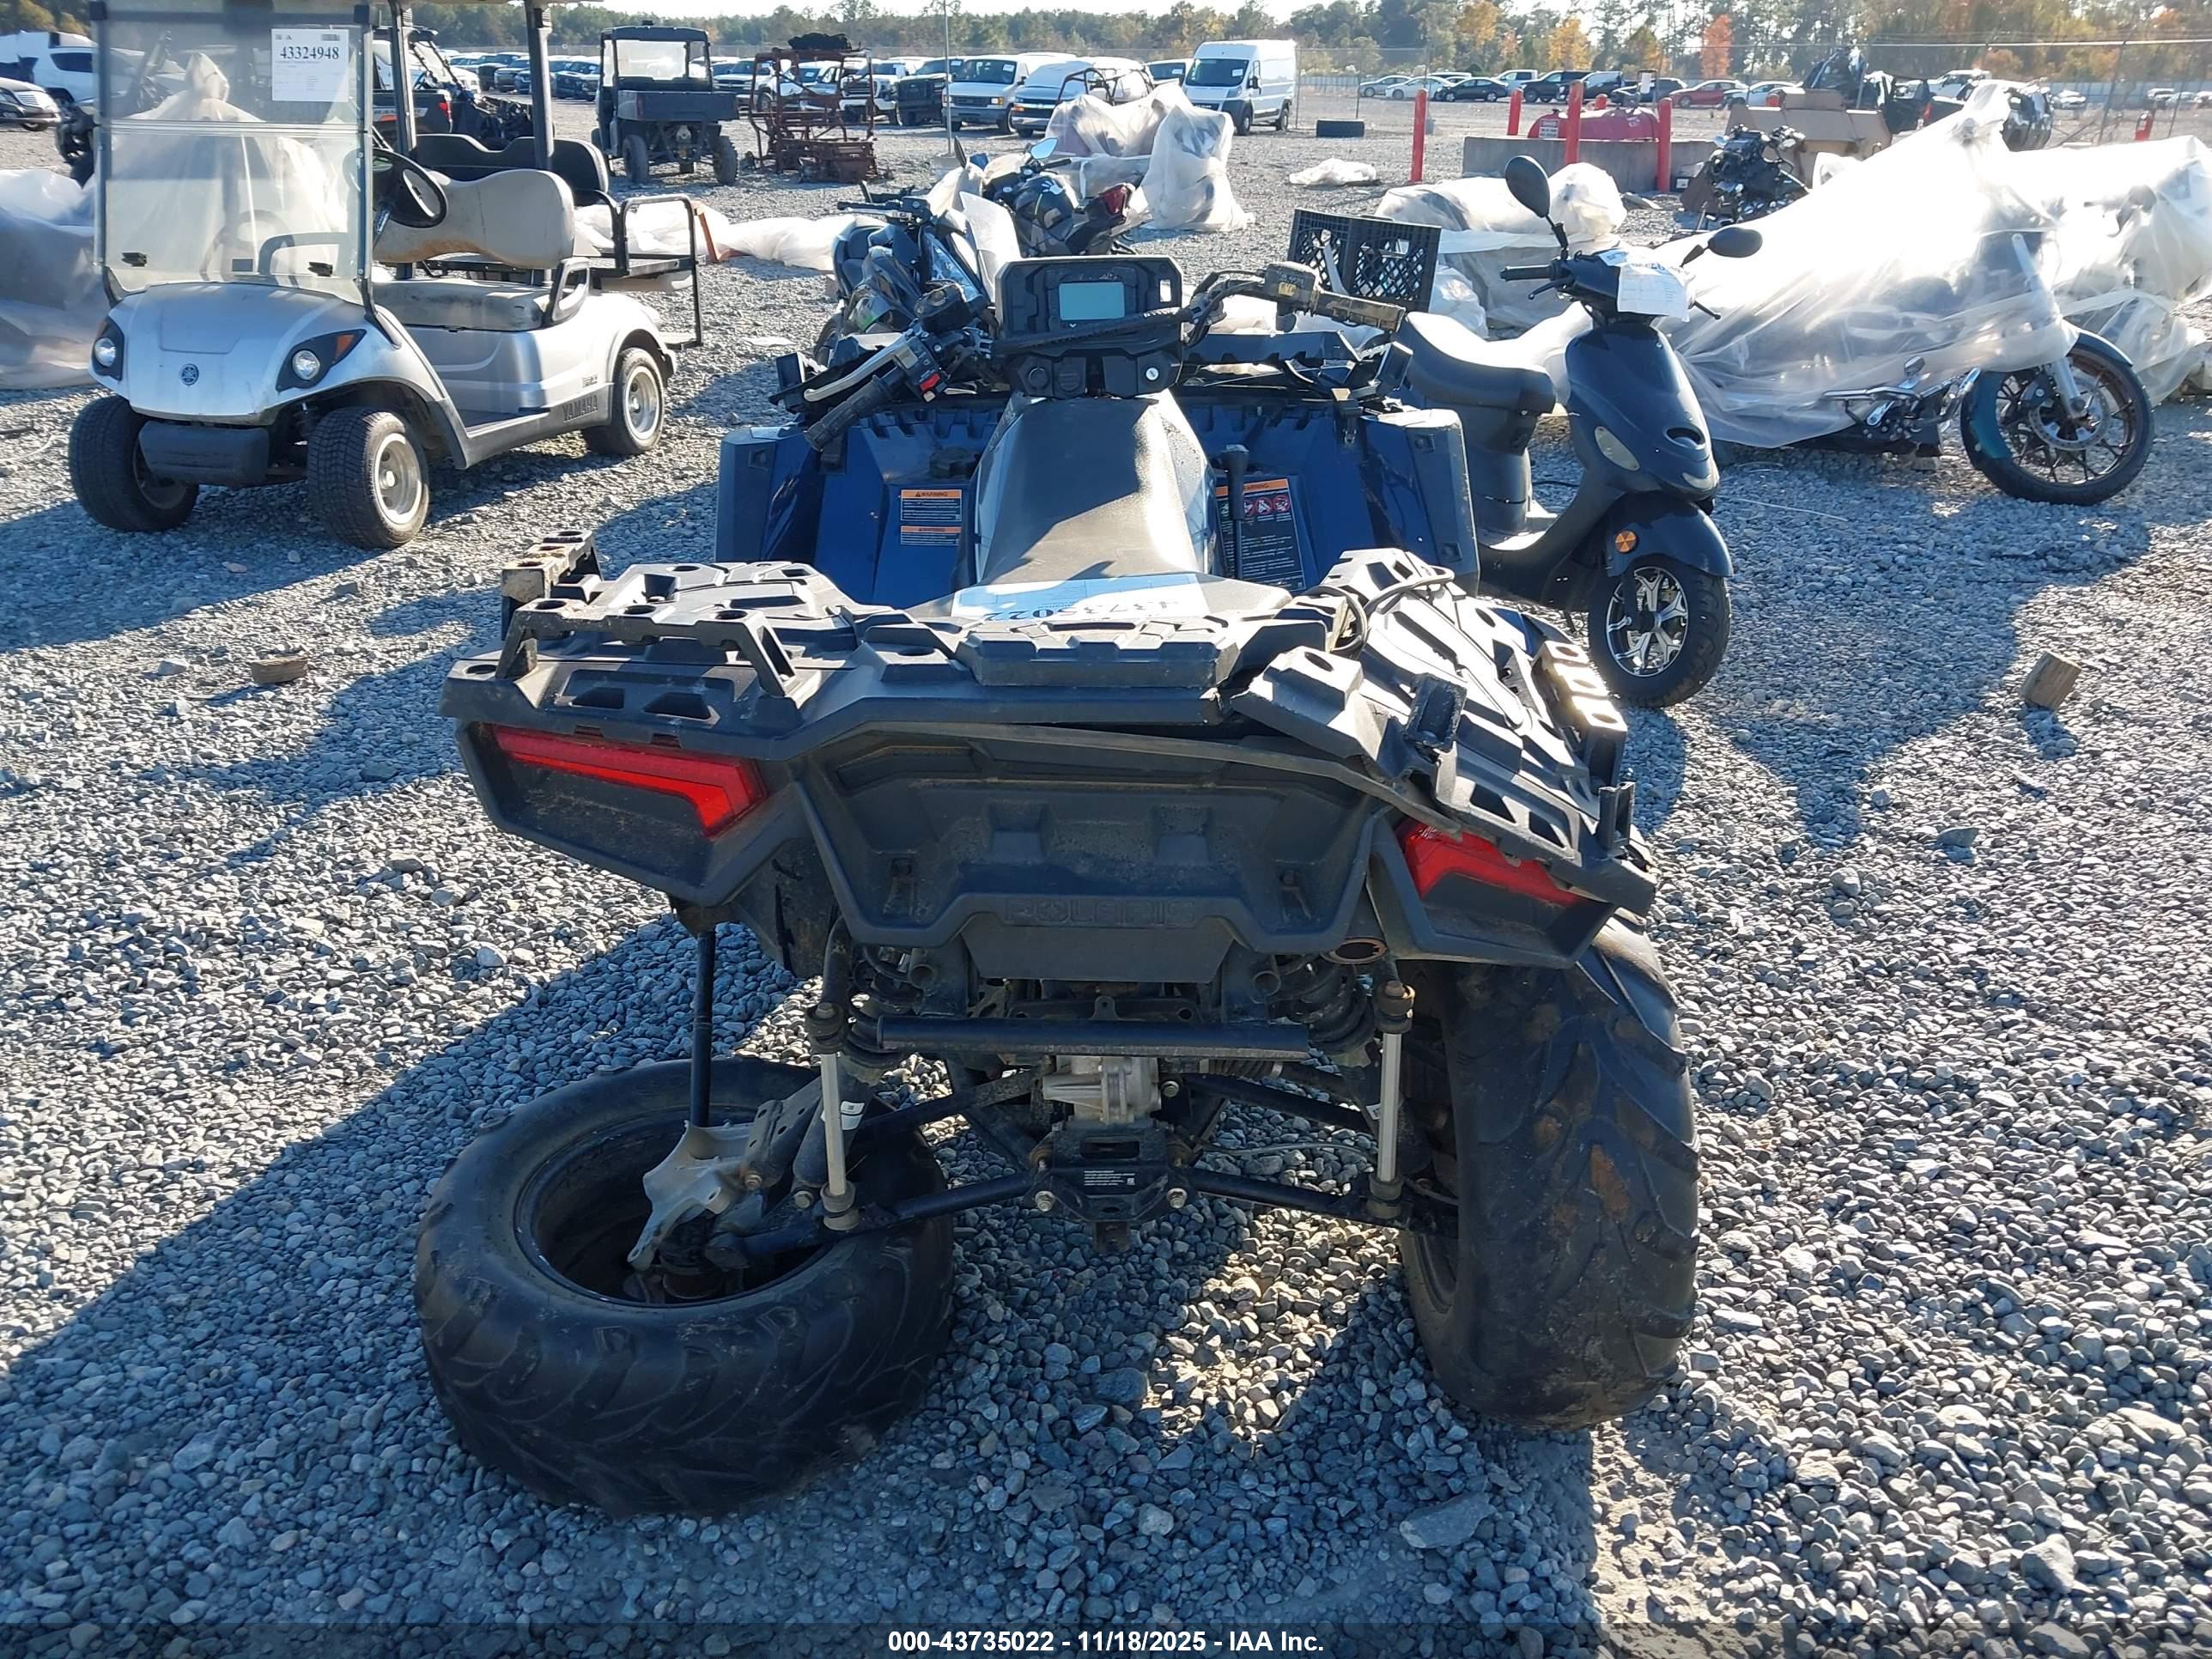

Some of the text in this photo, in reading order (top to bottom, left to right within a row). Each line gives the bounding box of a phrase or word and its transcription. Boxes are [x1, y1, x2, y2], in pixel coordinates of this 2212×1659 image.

[280, 46, 340, 60] 43324948
[563, 395, 598, 421] YAMAHA
[1004, 898, 1196, 927] POLARIS
